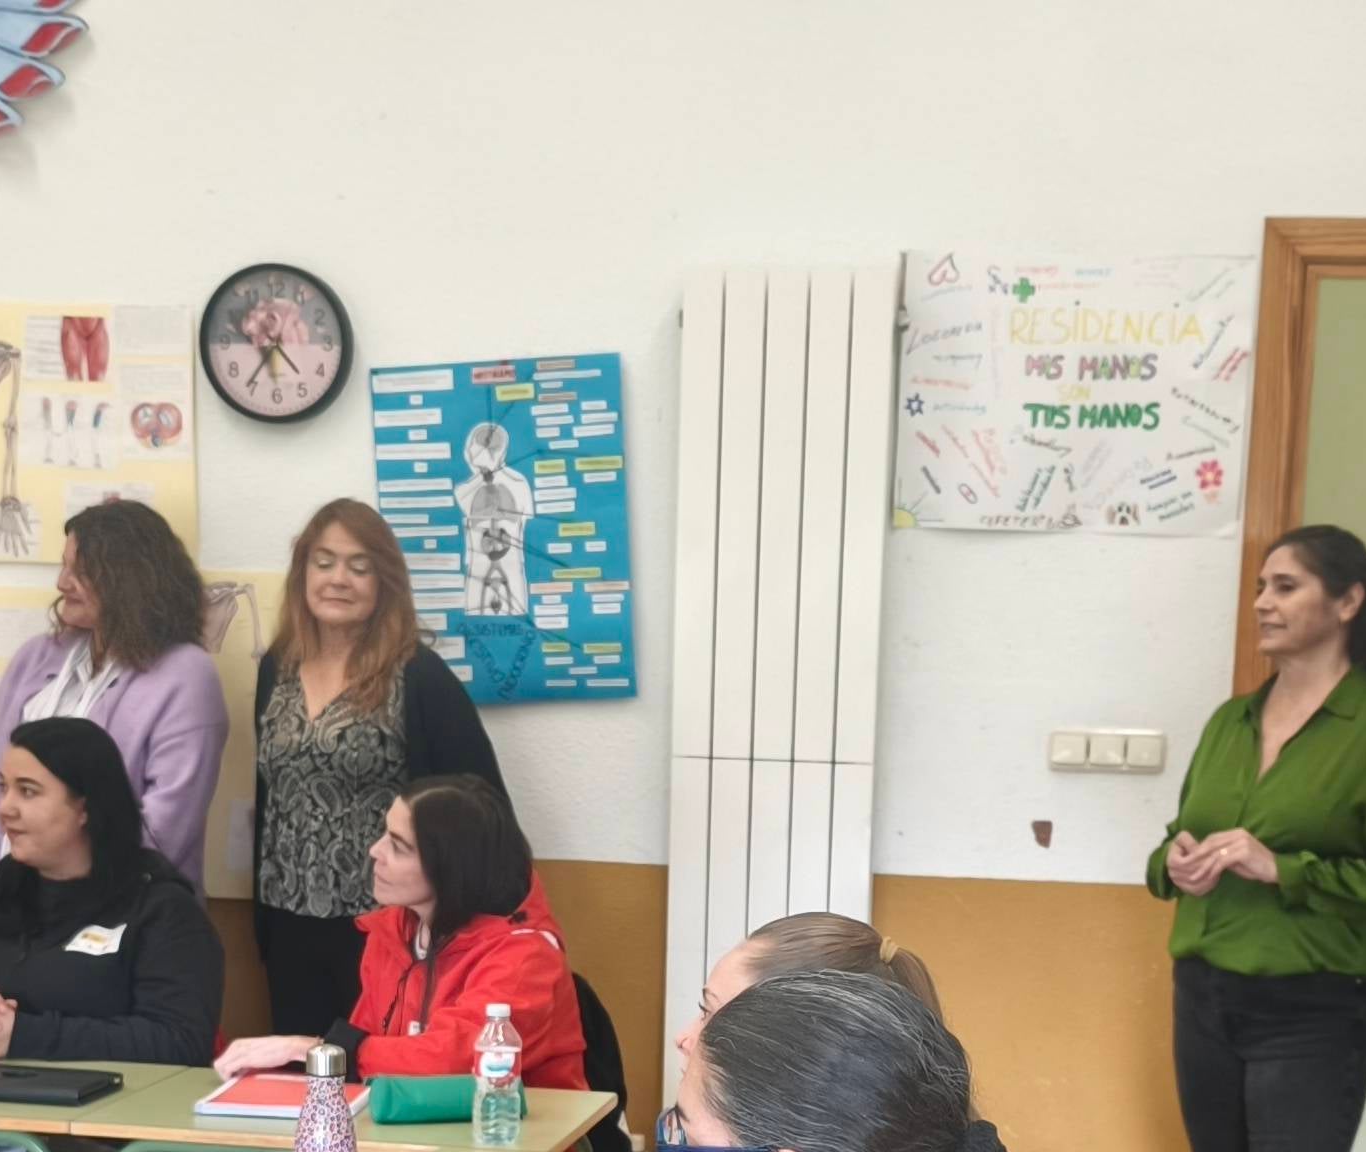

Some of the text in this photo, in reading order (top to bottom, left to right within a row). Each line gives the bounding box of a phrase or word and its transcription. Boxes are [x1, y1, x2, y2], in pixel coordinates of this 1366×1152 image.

[269, 283, 284, 297] 12
[314, 308, 325, 326] 2
[1009, 302, 1205, 346] RESIDENCIA
[219, 334, 231, 350] 9
[322, 336, 333, 352] 3
[228, 361, 239, 378] 8
[315, 362, 325, 377] 4
[1024, 354, 1159, 381] MIS MANOS
[271, 387, 283, 404] 6
[298, 382, 308, 398] 5
[1023, 402, 1071, 430] TUS
[1078, 402, 1161, 431] MANOS
